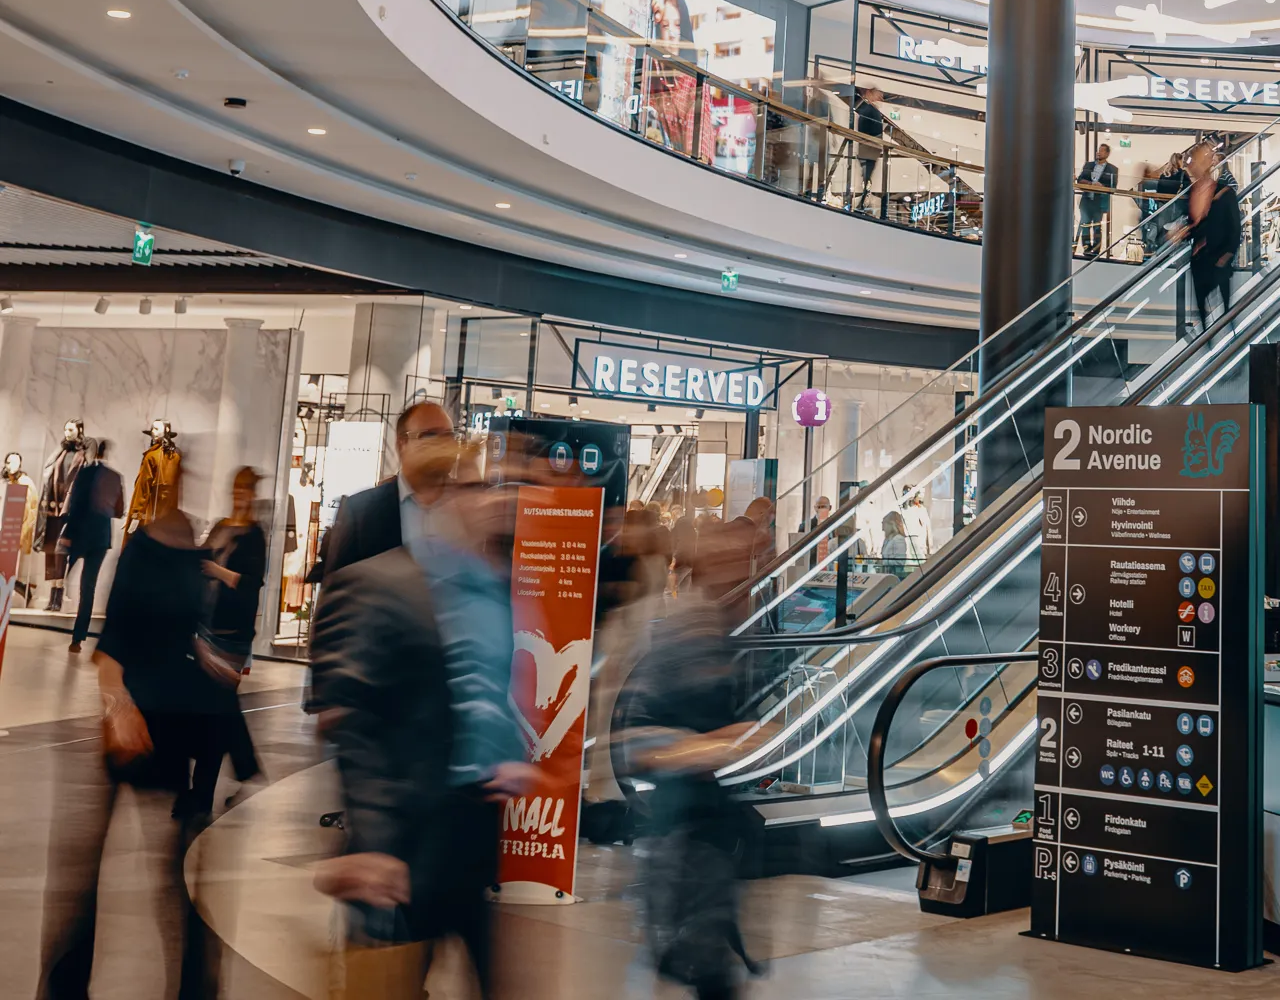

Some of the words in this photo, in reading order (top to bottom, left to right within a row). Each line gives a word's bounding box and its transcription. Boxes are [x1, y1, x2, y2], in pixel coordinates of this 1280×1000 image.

[594, 356, 764, 406] RESERVED
[1089, 424, 1152, 444] Nordic
[1053, 420, 1081, 470] 2
[1087, 451, 1161, 470] Avenue
[1112, 498, 1135, 506] Viihde
[1047, 496, 1062, 525] 5
[1111, 521, 1153, 530] Hyvinvointi
[1110, 561, 1165, 571] Rautatieasema
[1044, 572, 1061, 602] 4
[1110, 600, 1134, 609] Hotelli
[1109, 624, 1141, 635] Workery
[1182, 631, 1191, 642] W
[1042, 648, 1058, 678] 3
[1108, 663, 1166, 675] Fredikanterassi
[1038, 680, 1061, 688] Downtown
[1107, 708, 1151, 720] Pasilankatu
[1040, 717, 1057, 748] 2
[1107, 739, 1133, 750] Raiteet
[1142, 745, 1165, 758] 1-11
[1123, 751, 1139, 760] Tracks
[1101, 771, 1114, 779] WC
[1039, 794, 1054, 825] 1
[503, 796, 565, 838] MALL
[1105, 815, 1146, 828] Firdonkatu
[500, 839, 565, 860] TRIPLA
[1104, 859, 1144, 872] Pysäköinti
[1104, 870, 1128, 879] Parkering
[1131, 874, 1151, 883] Parking
